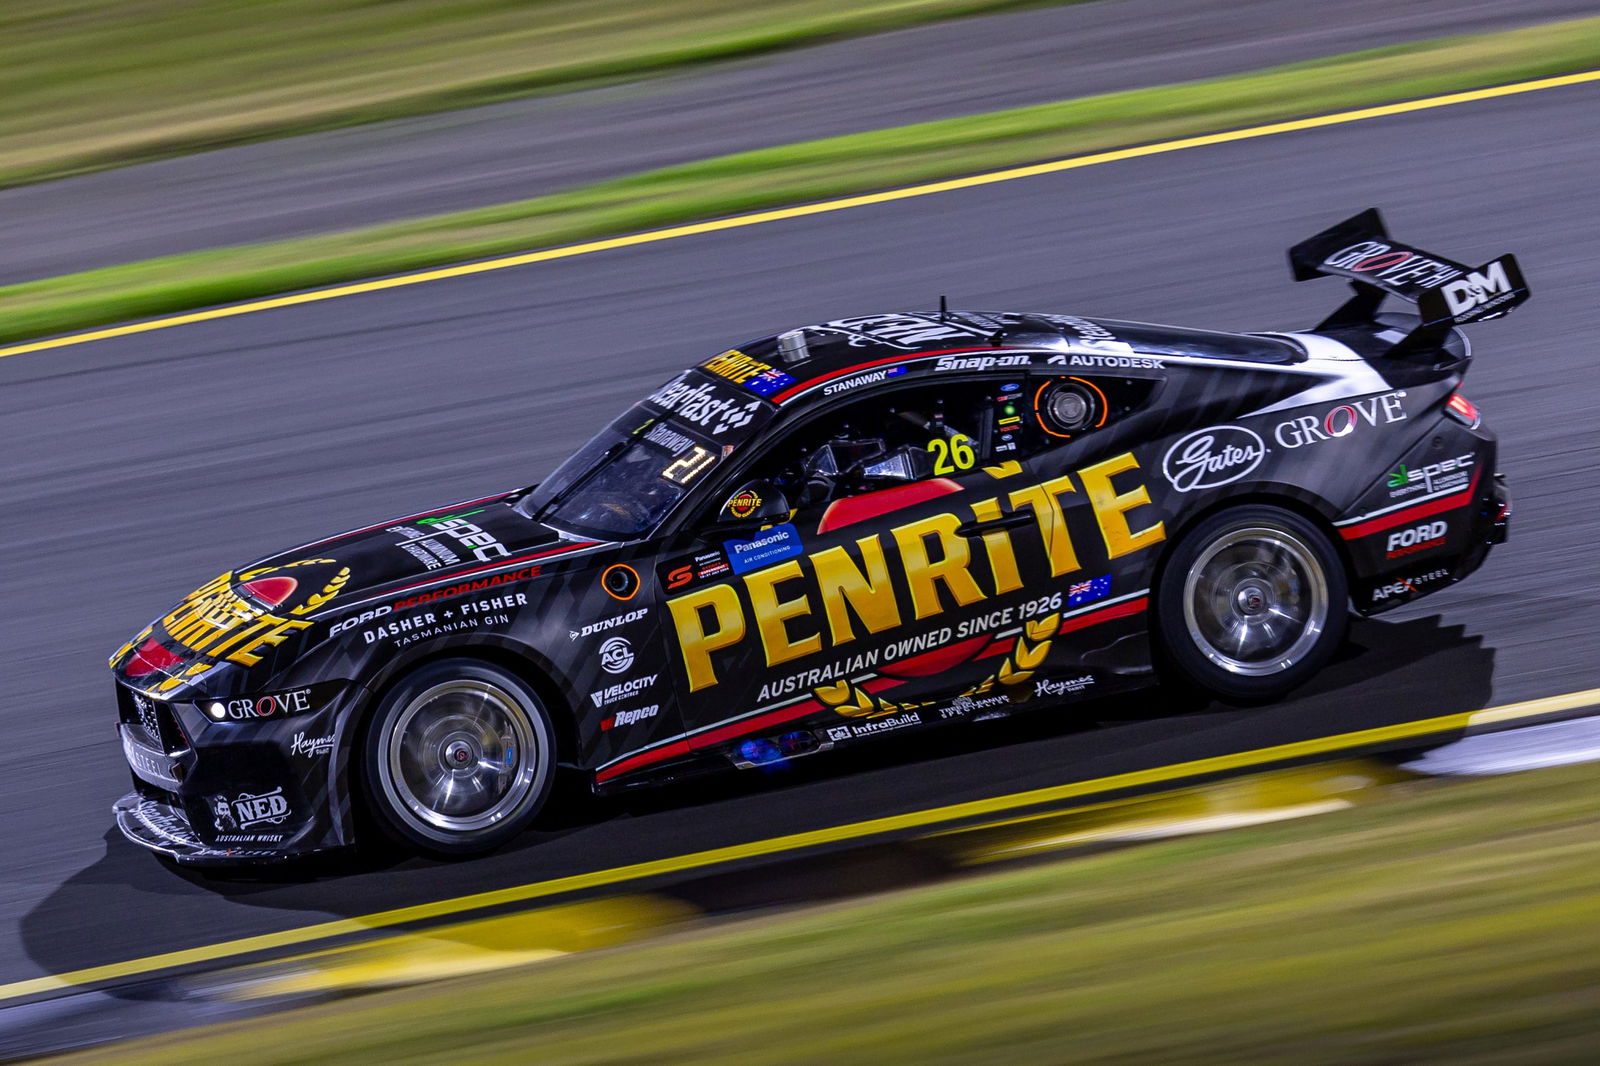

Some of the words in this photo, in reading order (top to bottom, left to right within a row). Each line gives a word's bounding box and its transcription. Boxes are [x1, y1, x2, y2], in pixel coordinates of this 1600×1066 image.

[1070, 355, 1165, 369] AUTODESK
[823, 371, 887, 396] STANAWAY
[646, 370, 735, 426] eadfast
[643, 421, 697, 457] Stanaway
[927, 433, 976, 476] 26
[1173, 432, 1259, 493] Gates
[727, 498, 762, 508] PENRITE
[734, 531, 790, 554] Panasonic
[1387, 520, 1448, 552] FORD
[755, 545, 791, 561] CONDITIONING
[665, 451, 1167, 694] PENRITE
[1373, 578, 1418, 601] APEX
[1415, 569, 1450, 585] STEEL
[329, 605, 392, 638] FORD
[393, 566, 542, 612] PERFORMANCE
[363, 614, 436, 644] DASHER
[461, 593, 528, 616] FISHER
[394, 620, 478, 647] TASMANIAN
[484, 614, 510, 625] GIN
[581, 608, 648, 637] DUNLOP
[601, 646, 634, 665] ACL
[757, 647, 880, 703] AUSTRALIAN
[883, 629, 951, 661] OWNED
[956, 608, 1012, 639] SINCE
[1018, 592, 1062, 620] 1926
[604, 674, 658, 699] VELOCITY
[1034, 675, 1095, 697] Haymes
[227, 690, 310, 720] GROVE
[614, 704, 659, 727] Repco
[852, 711, 920, 735] InfraBuild
[291, 731, 336, 758] Haymes
[235, 795, 288, 822] NED
[215, 834, 256, 842] AUSTRALIAN
[257, 834, 284, 842] WHISKY
